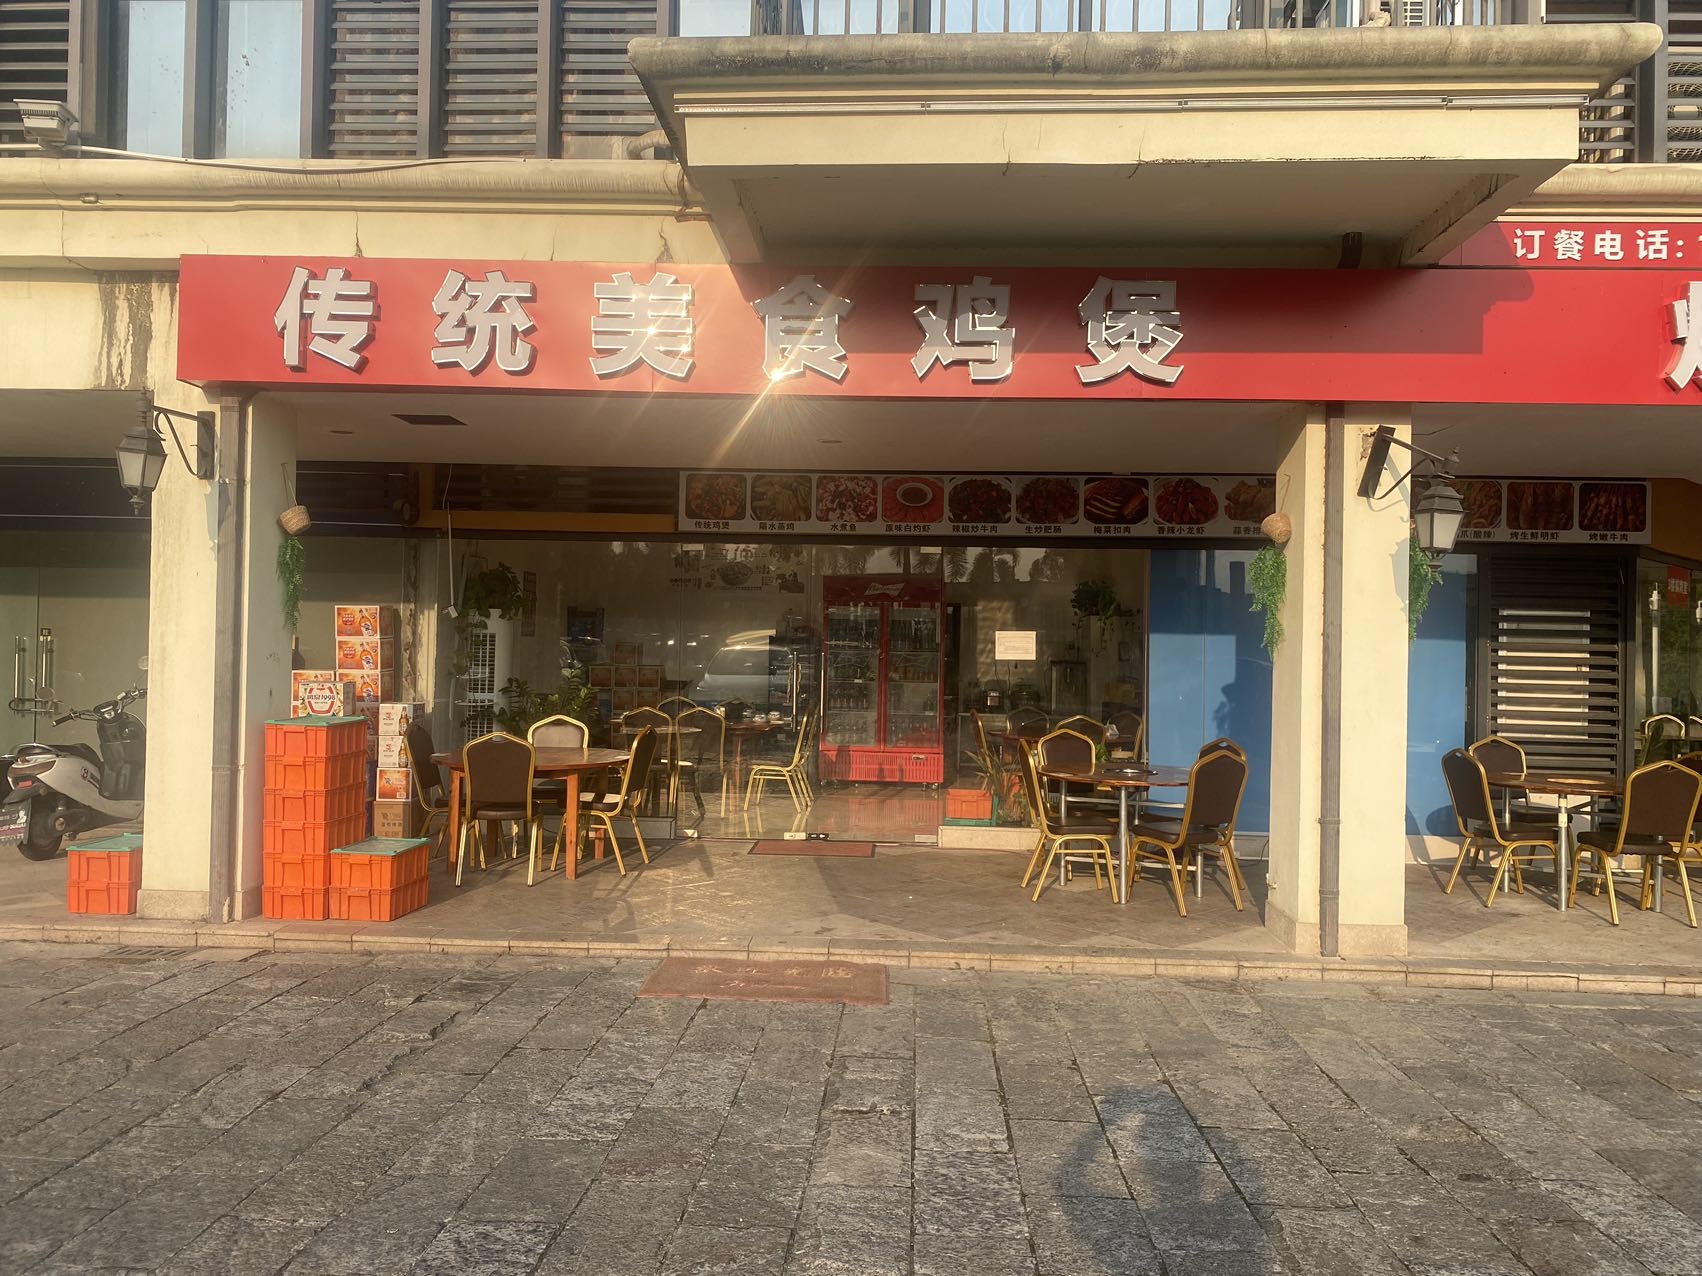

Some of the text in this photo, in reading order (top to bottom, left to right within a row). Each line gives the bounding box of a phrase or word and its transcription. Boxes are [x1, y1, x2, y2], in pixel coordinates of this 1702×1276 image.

[275, 266, 1185, 385] 传统美食鸡煲
[694, 520, 730, 531] 传统鸡煲
[830, 522, 857, 533] 水煮鱼
[885, 523, 931, 534] 原味白灼虾
[952, 523, 998, 534] 辣椒炒牛肉
[1024, 525, 1062, 535] 生炒肥肠
[1093, 525, 1131, 535] 梅菜扣肉
[1156, 526, 1205, 536] 香辣小龙虾
[1232, 526, 1262, 536] 蒜香排
[1457, 529, 1496, 539] 爪(酸辣)
[1509, 531, 1560, 541] 烤生鲜明虾
